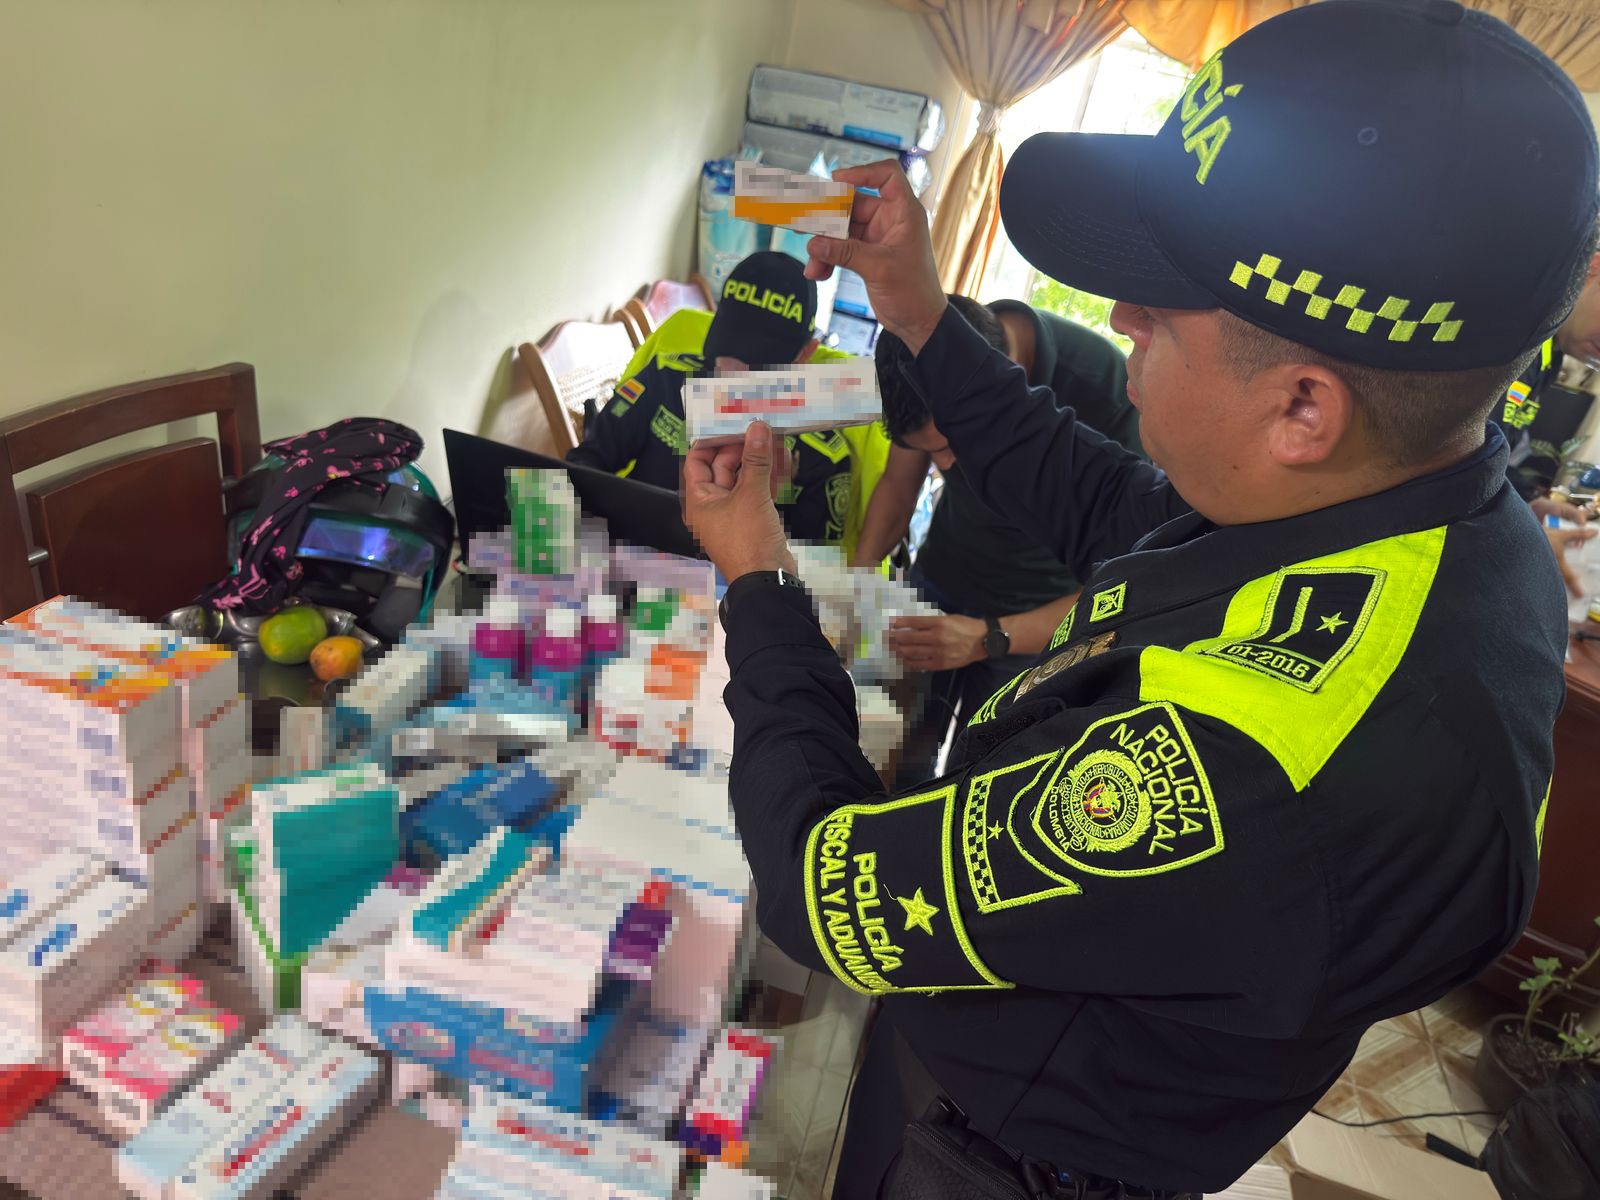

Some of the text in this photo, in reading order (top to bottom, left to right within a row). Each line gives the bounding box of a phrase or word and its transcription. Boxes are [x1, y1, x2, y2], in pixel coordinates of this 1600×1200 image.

[1180, 48, 1244, 185] CÍA
[723, 278, 803, 324] POLICÍA
[1227, 645, 1310, 679] 01-2016
[1110, 722, 1176, 856] NACIONAL
[1146, 723, 1207, 836] POLICÍA
[819, 811, 854, 889] FISCAL
[1049, 786, 1070, 852] COLOMBIA
[822, 889, 848, 906] Y
[852, 851, 904, 973] POLICÍA
